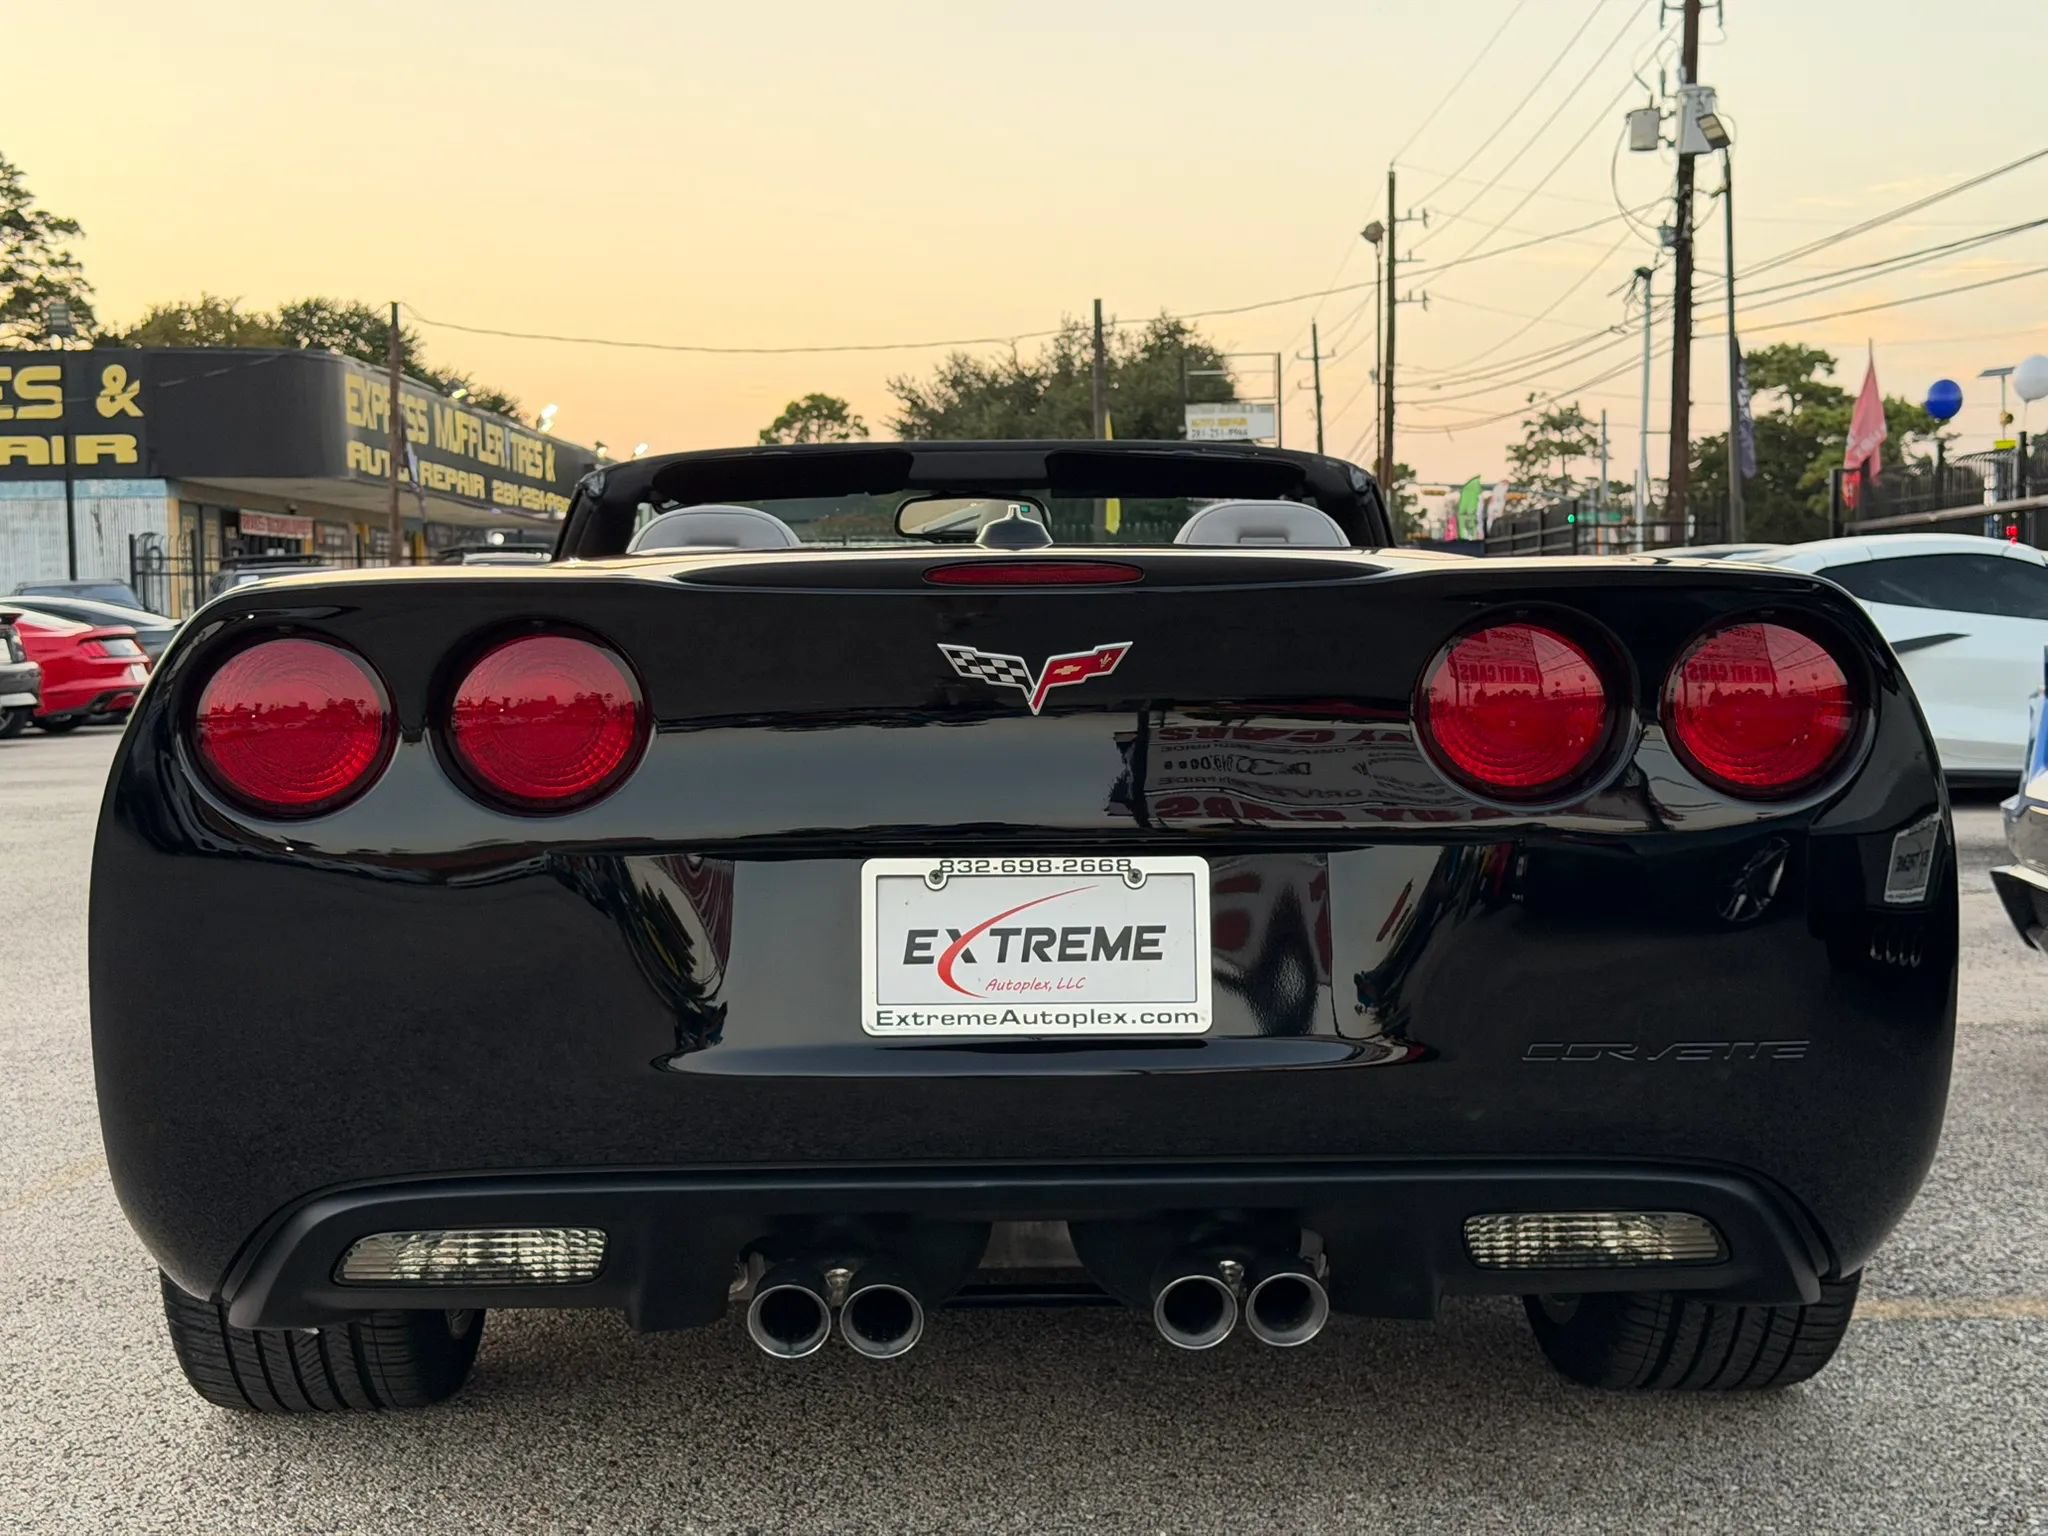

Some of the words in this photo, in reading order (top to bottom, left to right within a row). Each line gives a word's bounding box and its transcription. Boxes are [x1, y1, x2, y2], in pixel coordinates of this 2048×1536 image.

[0, 365, 63, 420] S
[96, 364, 144, 418] &
[434, 402, 506, 468] MUFFLER
[419, 461, 486, 499] REPAIR
[939, 859, 1132, 873] 832-698-2668
[903, 925, 1167, 965] EXTREME
[985, 977, 1052, 993] Autoplex,
[1056, 977, 1086, 989] LLC
[876, 1009, 1199, 1028] ExtremeAutoplex.com
